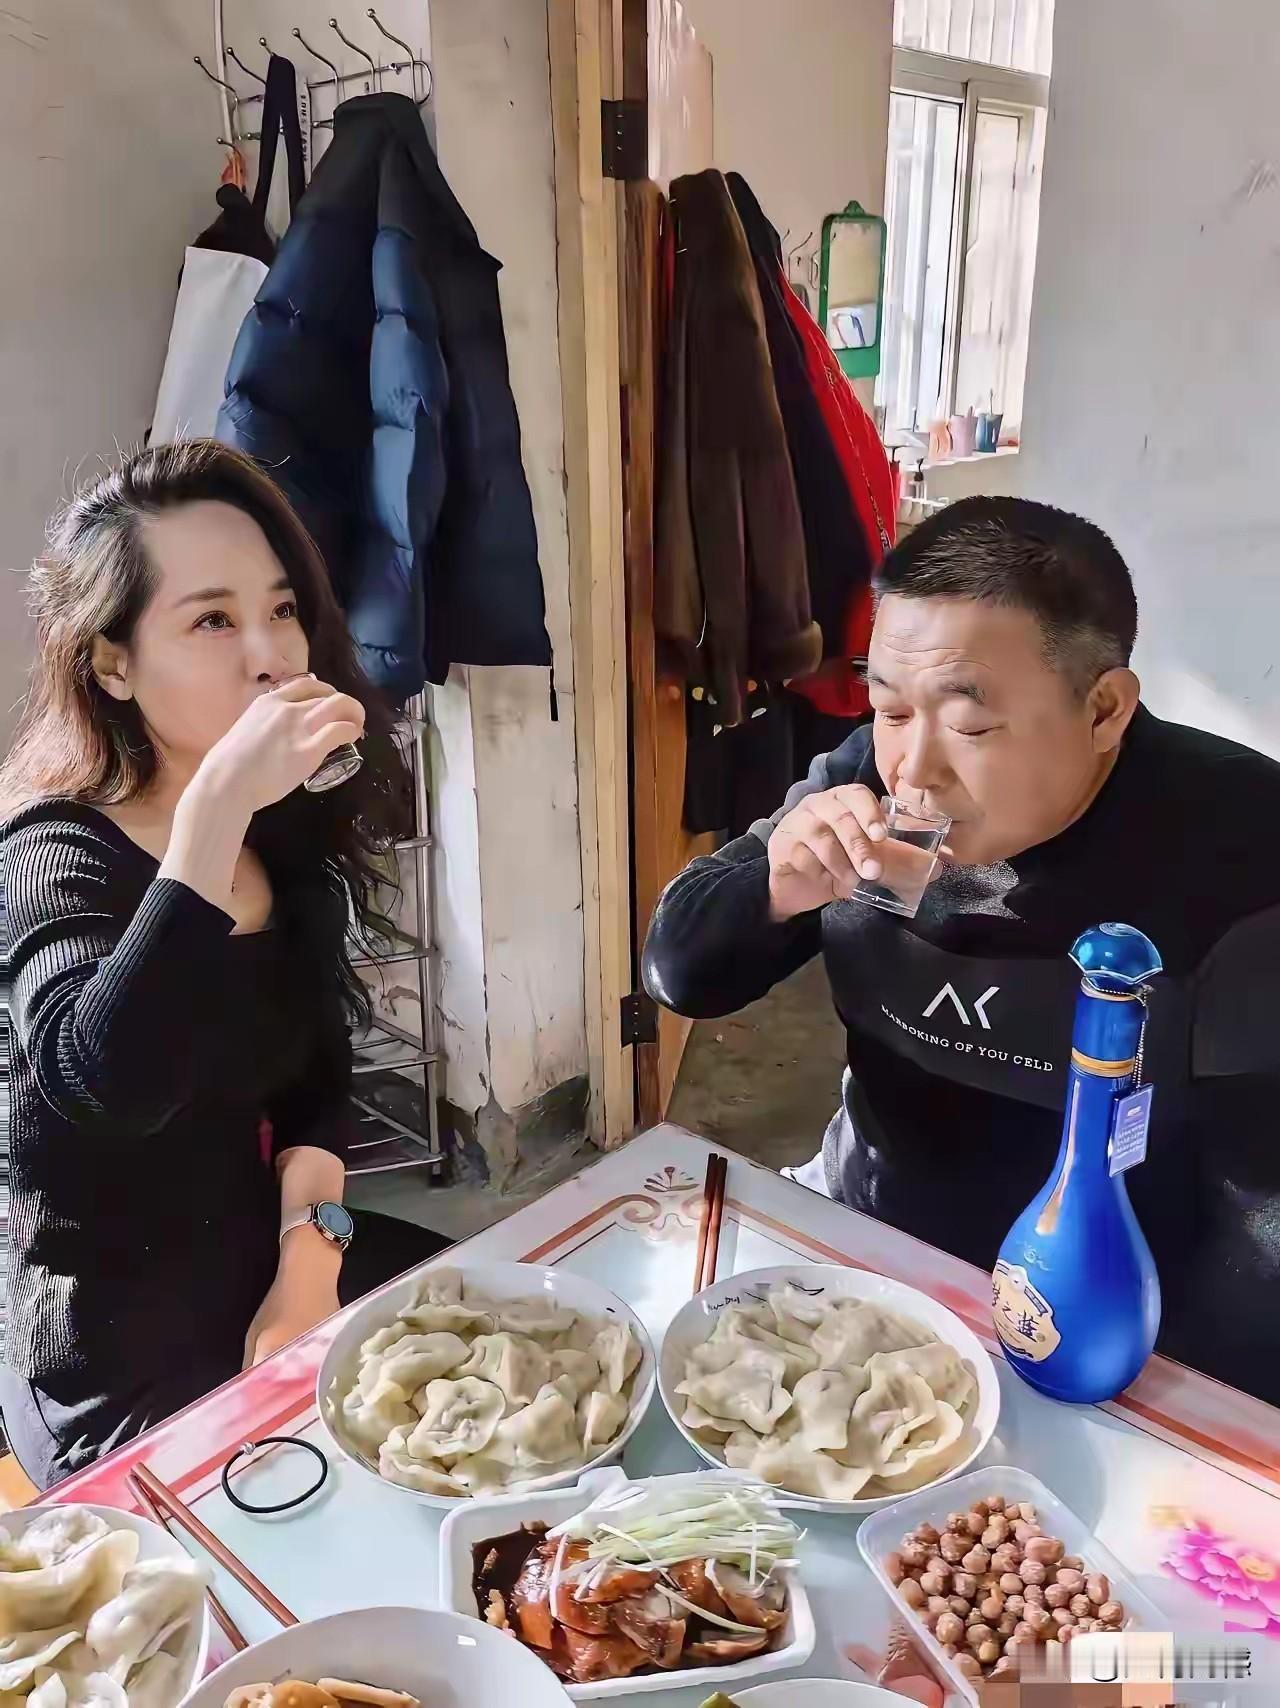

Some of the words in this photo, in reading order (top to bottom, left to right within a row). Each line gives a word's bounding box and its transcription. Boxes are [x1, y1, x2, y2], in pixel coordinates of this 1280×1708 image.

[955, 1041, 974, 1053] OF
[978, 1046, 1009, 1061] YOU
[1013, 1055, 1053, 1072] CELD
